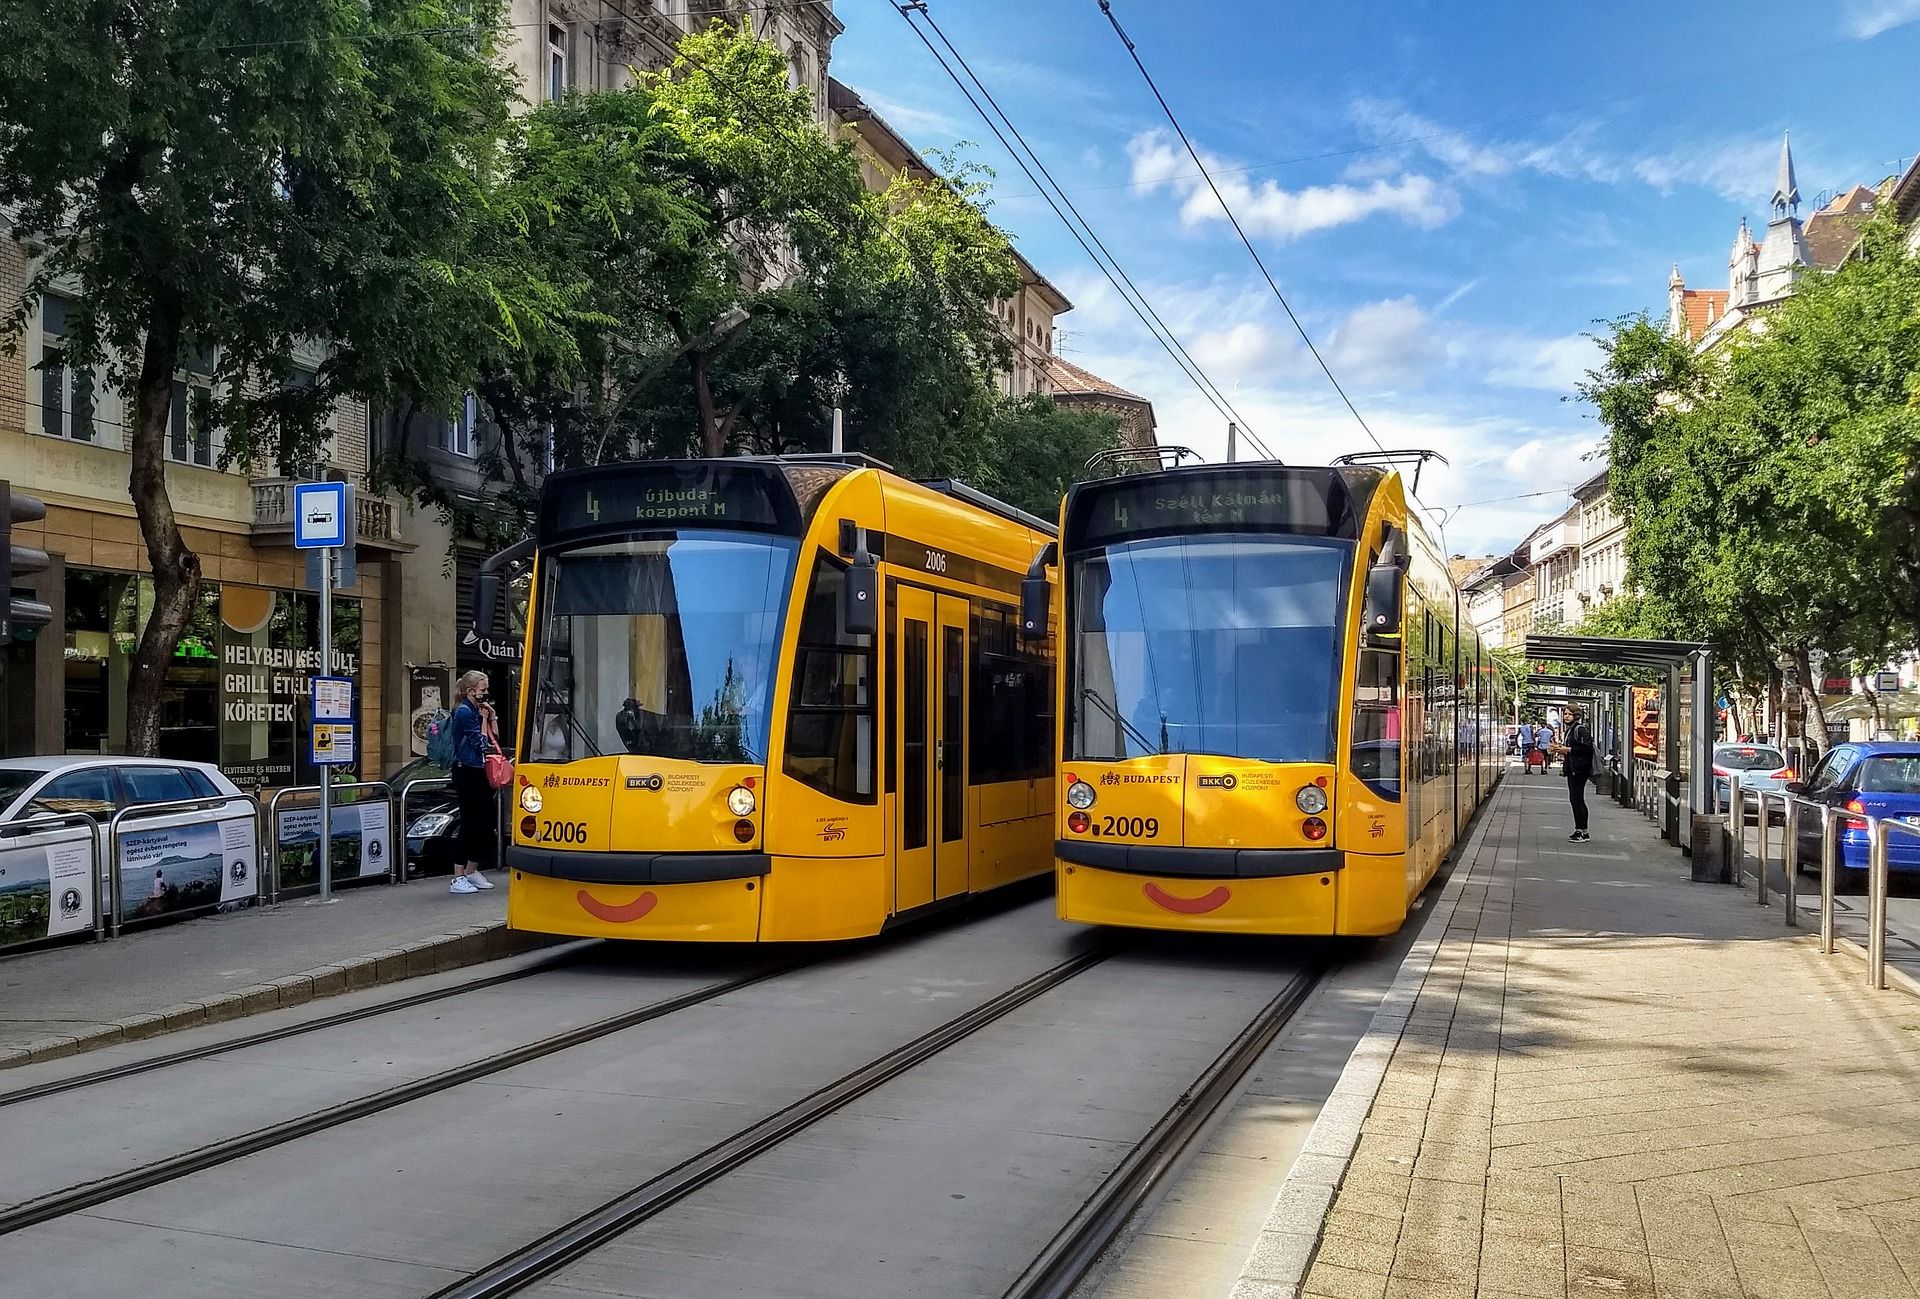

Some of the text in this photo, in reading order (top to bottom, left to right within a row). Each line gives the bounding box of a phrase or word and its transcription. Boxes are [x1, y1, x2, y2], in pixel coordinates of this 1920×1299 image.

[586, 491, 600, 521] 4
[1155, 490, 1282, 510] Széll Kálmán
[636, 502, 726, 519] központ M
[1114, 499, 1128, 528] 4
[1192, 508, 1244, 524] tér M
[925, 550, 946, 573] 2006
[225, 645, 355, 670] HELYBEN KÉSÜLT
[479, 638, 515, 660] Quán
[224, 674, 269, 693] GRILL
[273, 672, 313, 695] ÉTELE
[225, 698, 294, 722] KÖRETEK
[223, 766, 255, 775] ELVITELRE
[265, 765, 291, 773] HELYBEN
[1123, 775, 1181, 784] BUDAPEST
[562, 777, 611, 787] BUDAPEST
[629, 779, 647, 787] BKK
[542, 820, 587, 843] 2006
[1103, 816, 1159, 838] 2009
[126, 835, 168, 847] SZÉP-kártyával
[126, 847, 144, 856] egész
[162, 841, 188, 849] rengeteg
[126, 853, 152, 862] látnivaló
